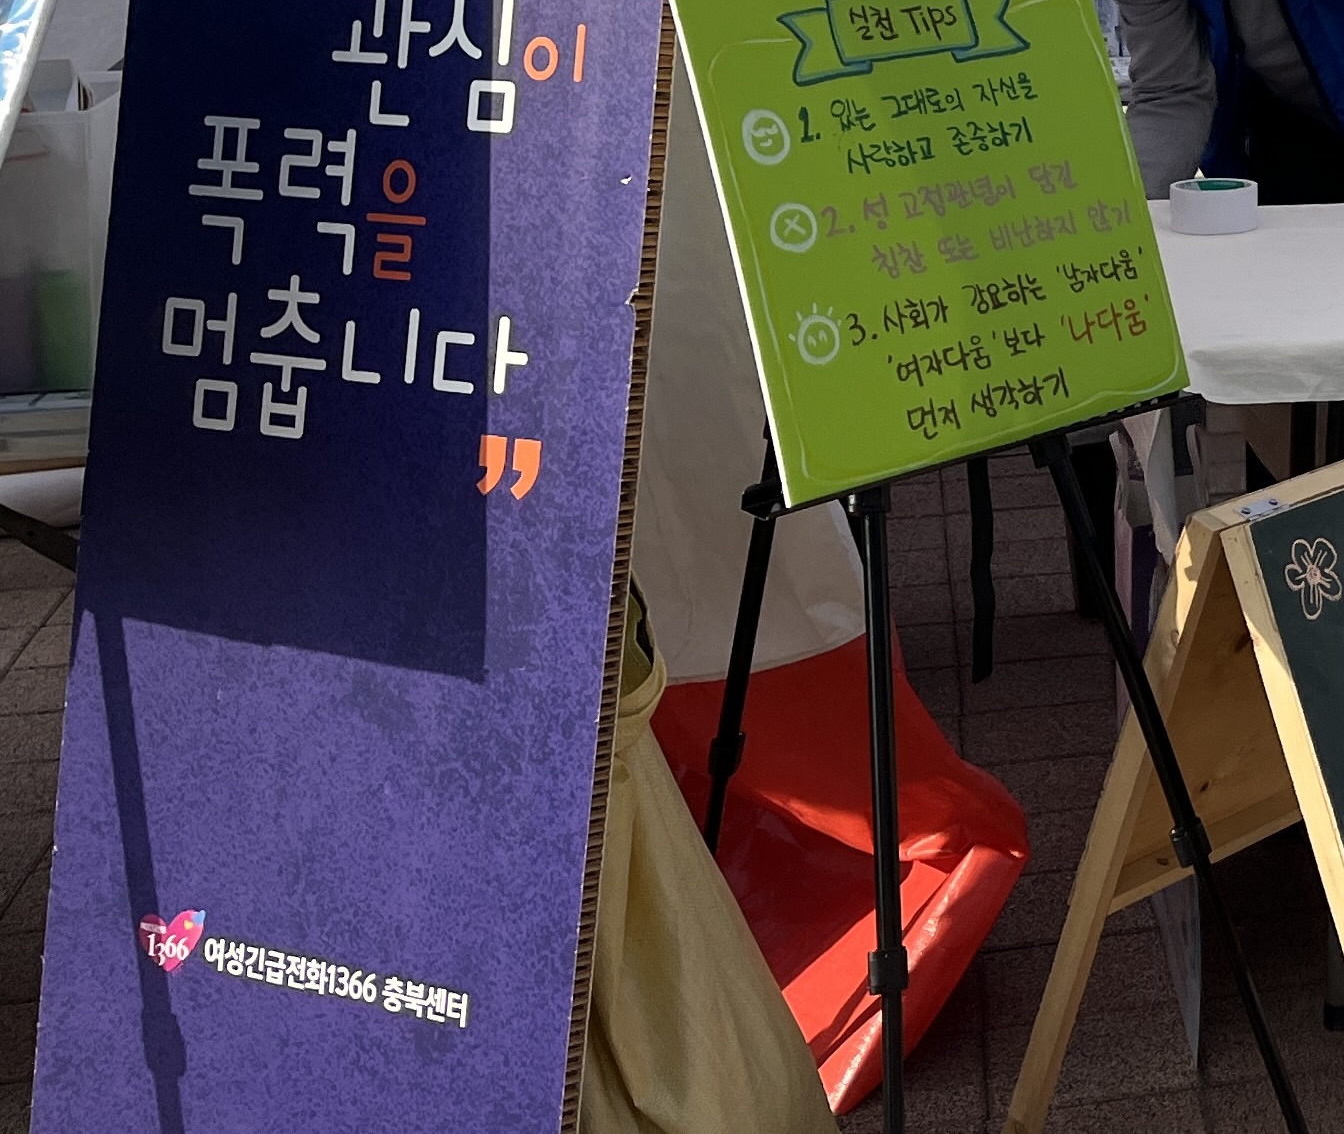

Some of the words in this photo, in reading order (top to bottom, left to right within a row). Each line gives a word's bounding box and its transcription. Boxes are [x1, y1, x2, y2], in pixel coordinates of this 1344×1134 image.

[848, 6, 899, 42] 실천
[798, 106, 821, 144] 1.
[829, 96, 877, 133] 있는
[881, 87, 966, 121] 그대로의
[971, 72, 1039, 106] 자신을
[846, 137, 936, 175] 사랑하고
[946, 116, 1034, 156] 존중하기
[188, 115, 427, 281] 폭력을
[821, 205, 856, 239] 2.
[862, 192, 889, 232] 성
[871, 239, 928, 280] 칭찬
[936, 233, 980, 265] 또는
[989, 209, 1079, 253] 비난하지
[1086, 198, 1132, 234] 않기
[846, 312, 878, 347] 3.
[883, 295, 949, 335] 사회가
[961, 272, 1048, 316] 강요하는
[162, 274, 529, 439] 멈춥니다
[906, 397, 962, 442] 먼저
[970, 367, 1070, 420] 생각하기
[204, 937, 378, 1003] 여성긴급전화1366
[381, 976, 469, 1028] 충북센터
